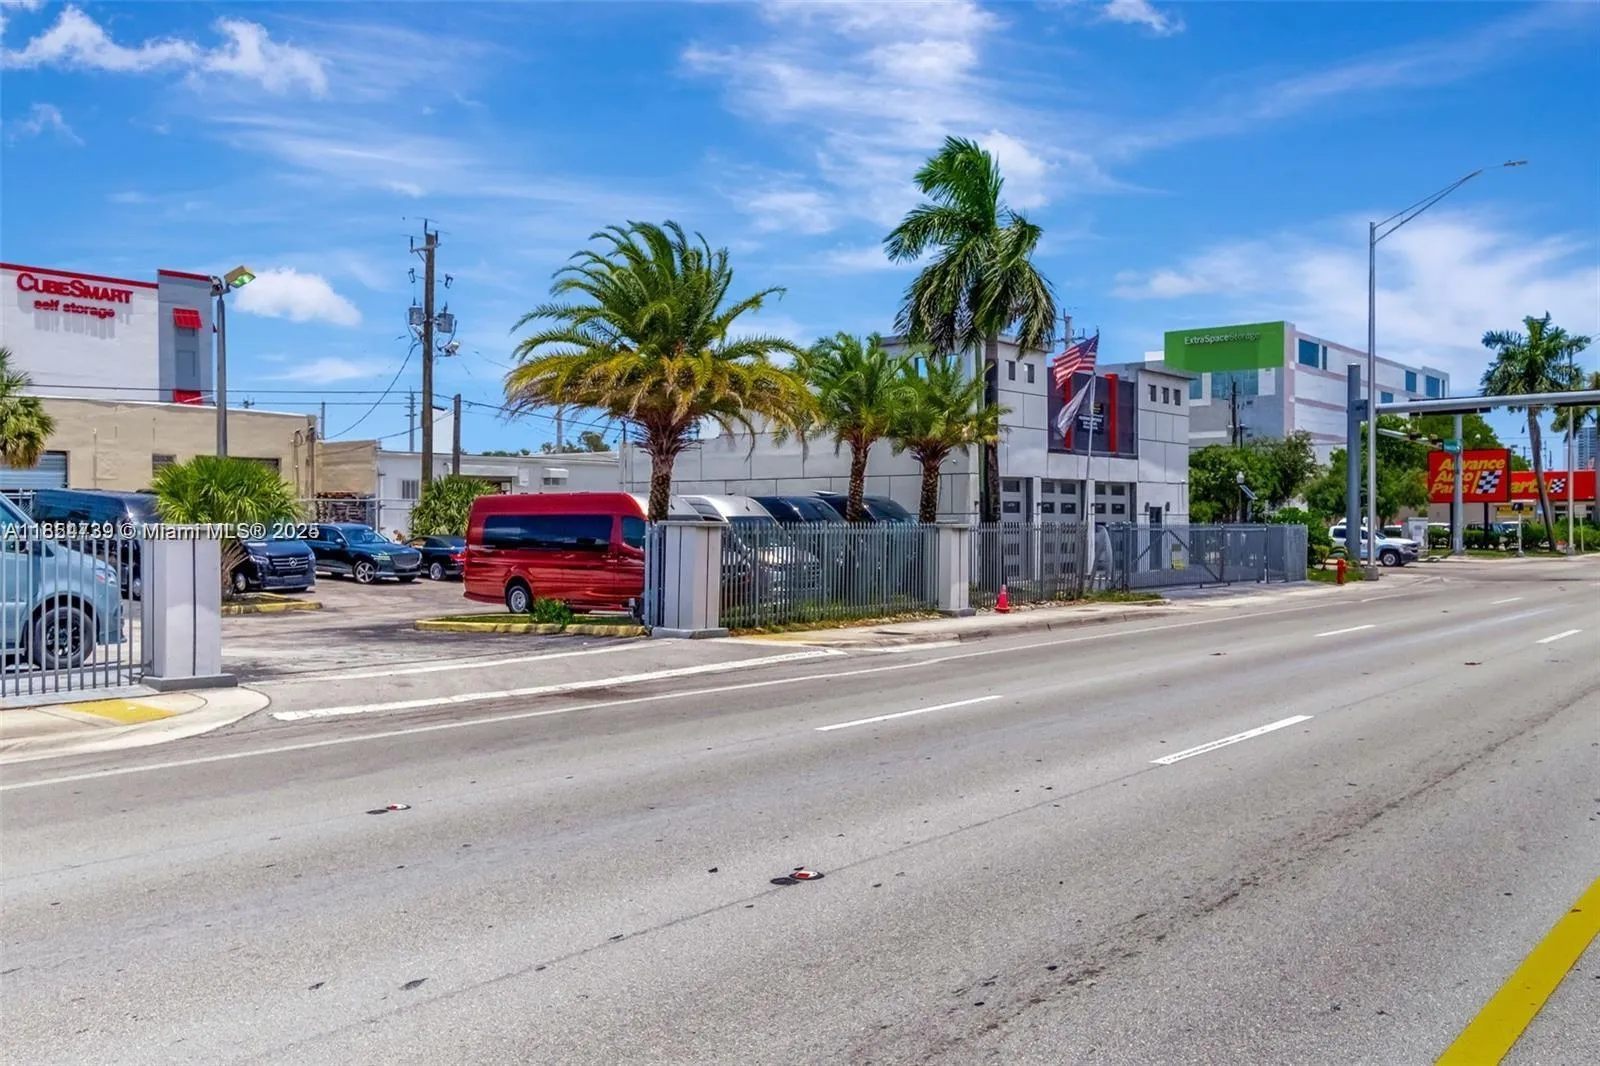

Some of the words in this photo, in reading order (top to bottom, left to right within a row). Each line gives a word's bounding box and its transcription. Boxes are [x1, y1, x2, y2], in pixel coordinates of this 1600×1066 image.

[34, 299, 59, 311] self
[63, 302, 115, 319] storage
[1439, 458, 1506, 471] Avance
[1435, 470, 1474, 483] Auo
[1431, 482, 1470, 494] Pars
